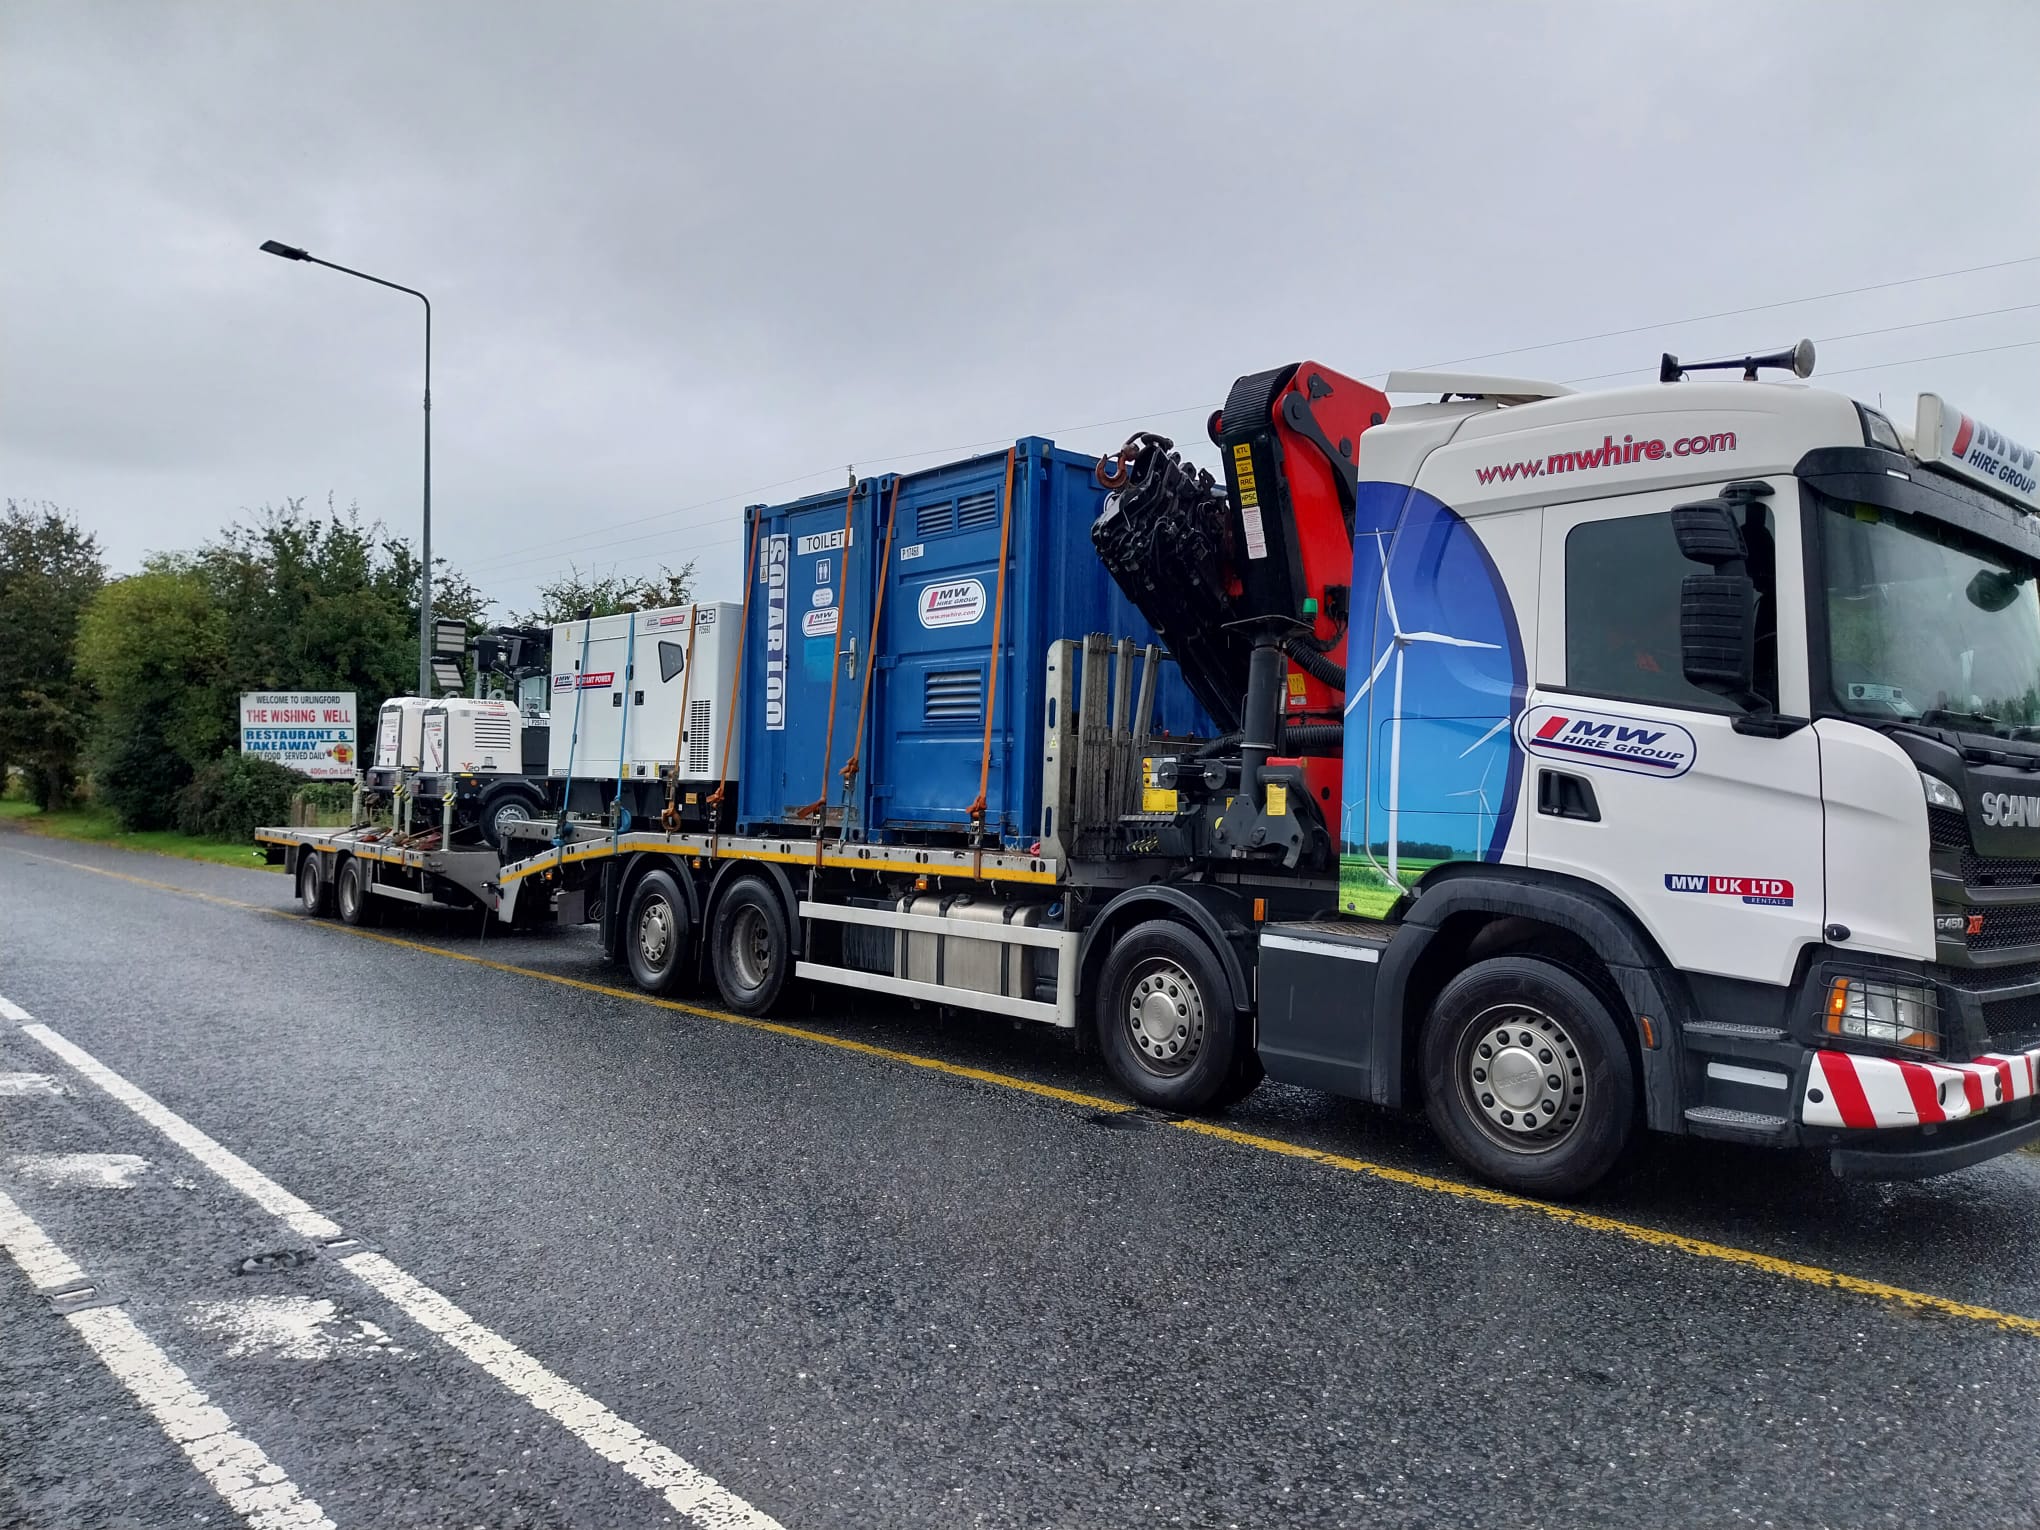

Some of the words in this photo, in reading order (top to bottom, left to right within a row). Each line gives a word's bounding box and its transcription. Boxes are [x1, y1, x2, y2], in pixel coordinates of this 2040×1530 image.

[1475, 431, 1737, 486] www.mwhire.com
[1968, 449, 1999, 475] HIRE
[1998, 465, 2037, 494] GROUP
[806, 531, 844, 551] TOILET
[768, 540, 785, 651] SOLAR
[939, 587, 970, 600] MW
[936, 599, 953, 607] HIRE
[954, 596, 978, 605] GROUP
[815, 611, 833, 619] MW
[925, 610, 976, 621] www.mwhire.com
[767, 661, 782, 724] LOO
[256, 696, 289, 704] WELCOME
[290, 696, 299, 704] TO
[301, 696, 341, 704] URLINGFORD
[246, 710, 268, 723] THE
[271, 710, 316, 723] WISHING
[323, 710, 351, 722] WELL
[246, 730, 332, 740] RESTAURANT
[338, 730, 347, 740] &
[1570, 720, 1667, 746] MW
[245, 741, 317, 751] TAKEAWAY
[1562, 735, 1609, 750] HIRE
[1613, 743, 1685, 761] GROUP
[264, 752, 281, 760] FOOD
[284, 752, 308, 760] SERVED
[309, 752, 326, 760] DAILY
[1982, 792, 2040, 828] SCANI
[1671, 876, 1705, 890] MW
[1715, 878, 1742, 893] UK
[1751, 880, 1784, 895] LTD
[1752, 897, 1786, 905] RENTALS
[1936, 917, 1964, 929] G450
